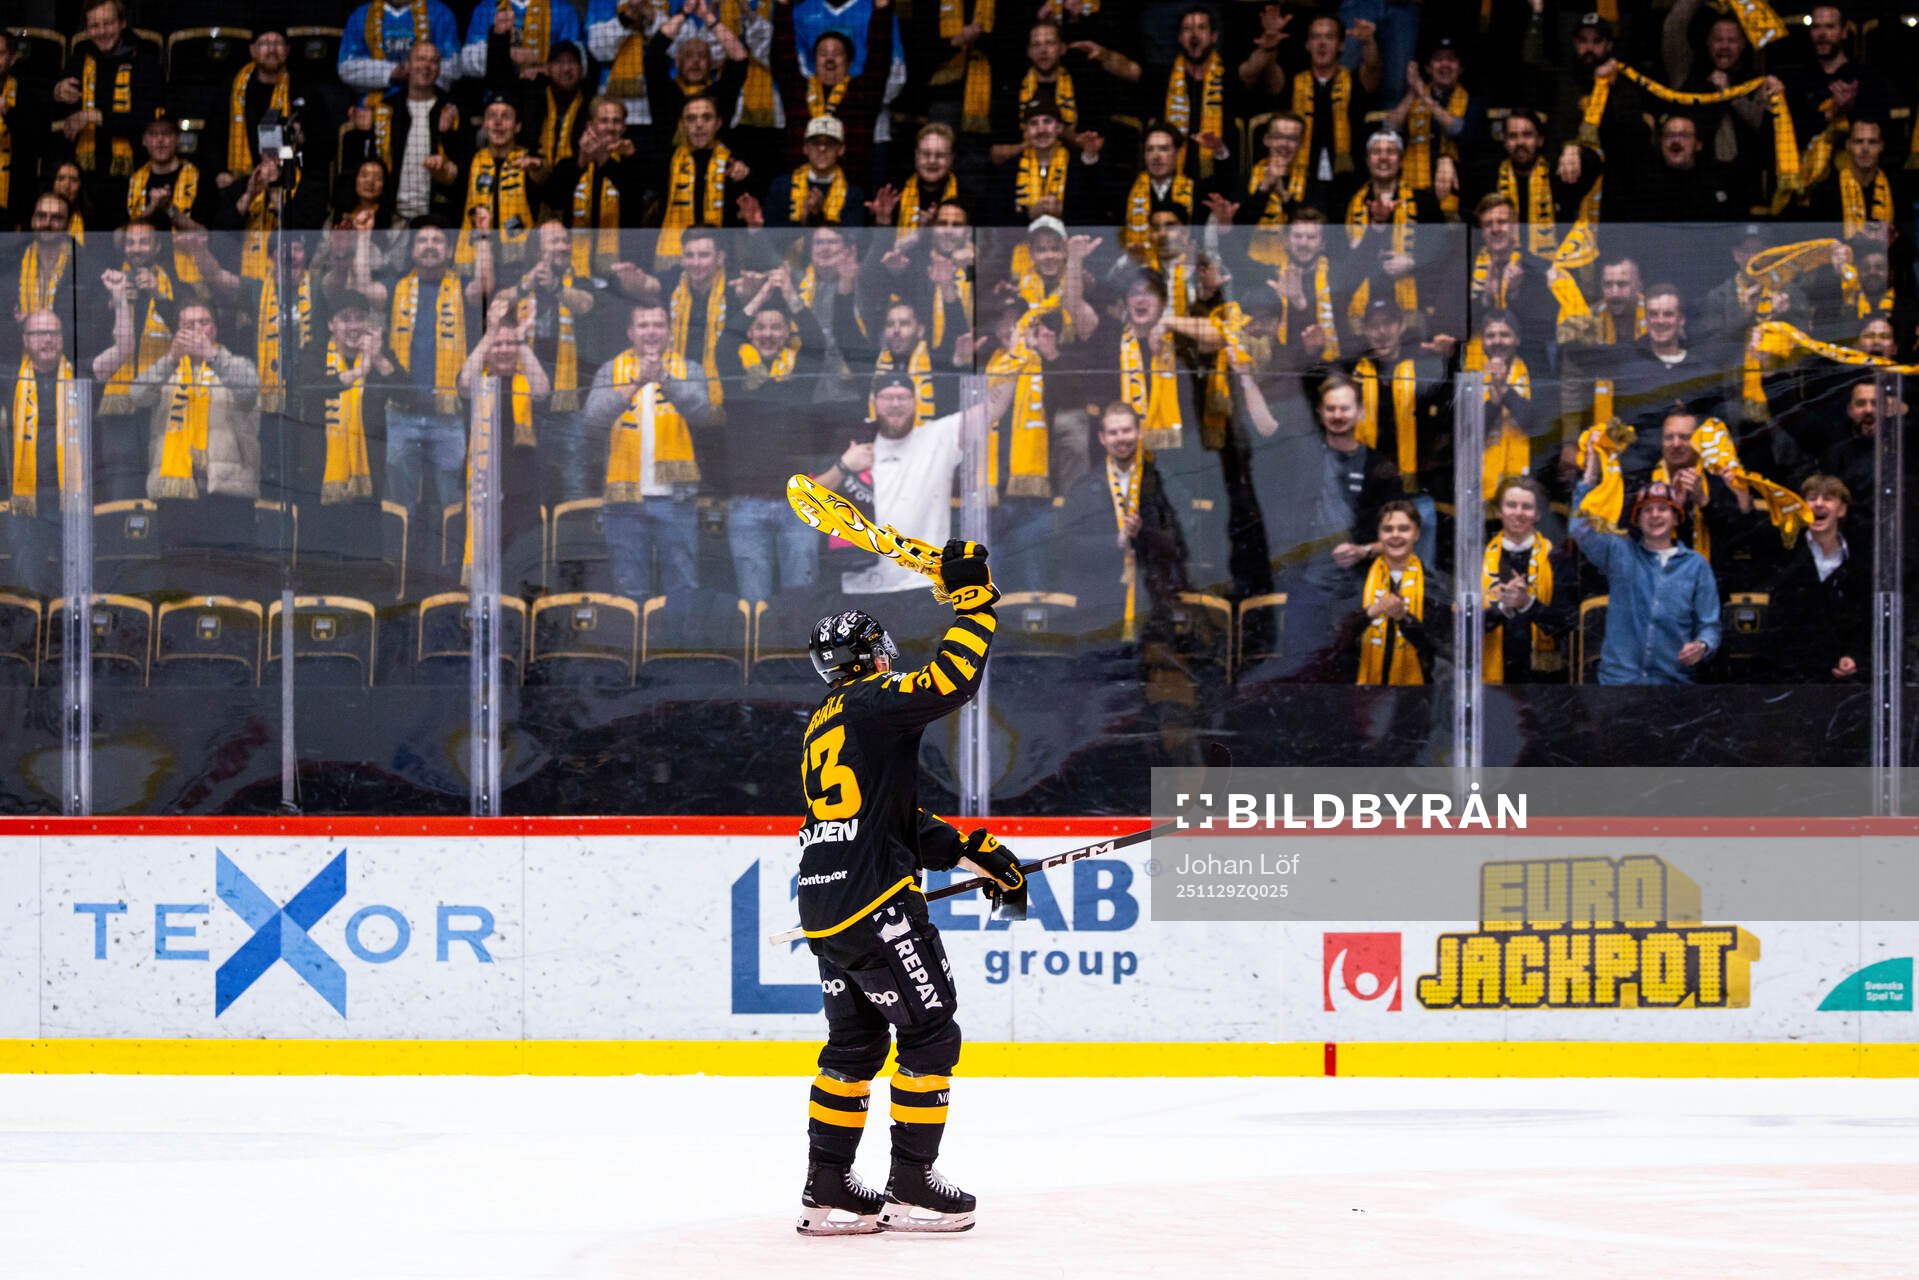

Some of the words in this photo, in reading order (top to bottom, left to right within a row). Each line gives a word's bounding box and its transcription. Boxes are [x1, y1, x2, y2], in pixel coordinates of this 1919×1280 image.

[822, 650, 833, 661] 33
[801, 725, 862, 820] 3
[1042, 841, 1115, 870] CCM
[1483, 861, 1663, 931] EURO
[73, 847, 495, 1019] TEXOR
[985, 950, 1139, 985] group
[1419, 931, 1734, 1006] JACKPOT
[894, 938, 943, 1010] REPAY
